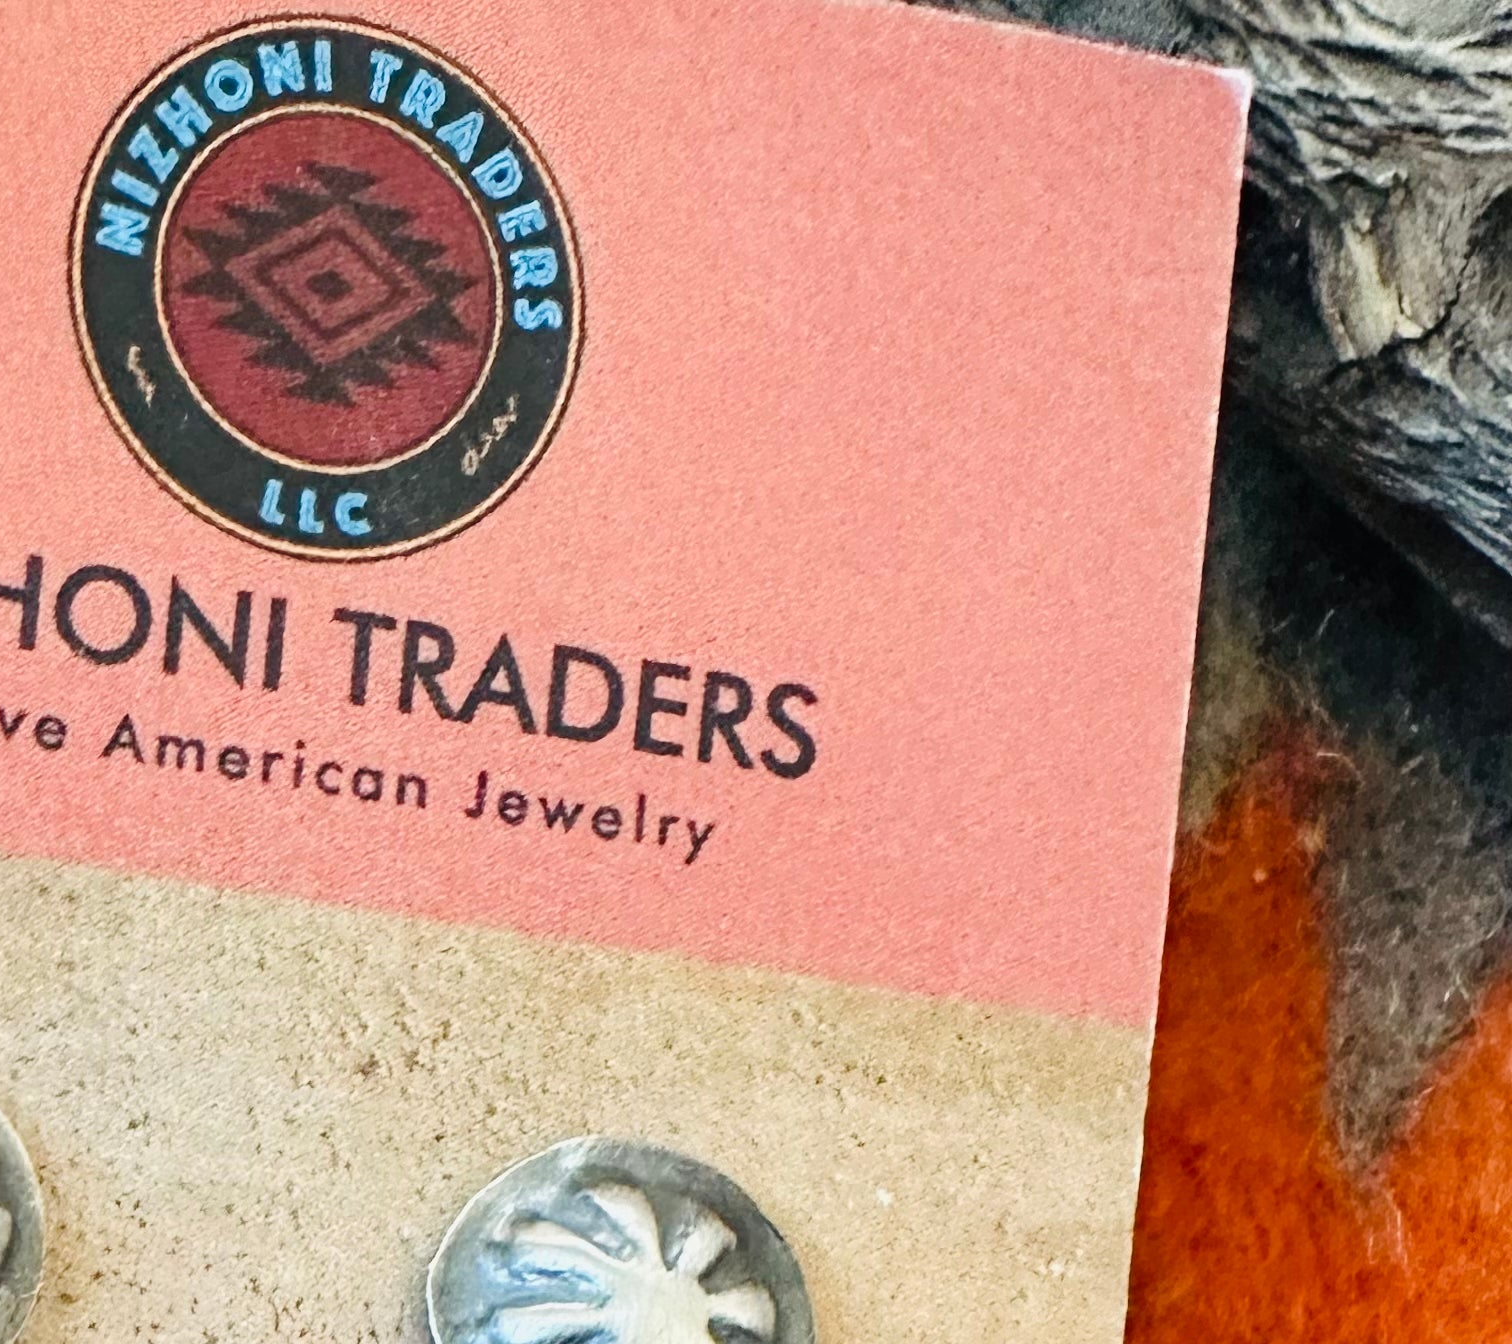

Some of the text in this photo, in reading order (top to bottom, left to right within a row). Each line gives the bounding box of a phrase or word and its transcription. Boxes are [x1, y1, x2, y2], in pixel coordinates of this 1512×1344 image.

[94, 40, 564, 332] NIZHONI TRADERS
[258, 479, 372, 537] LLC
[330, 606, 820, 780] TRADERS
[98, 713, 428, 810] American
[462, 769, 716, 866] Jewelry
